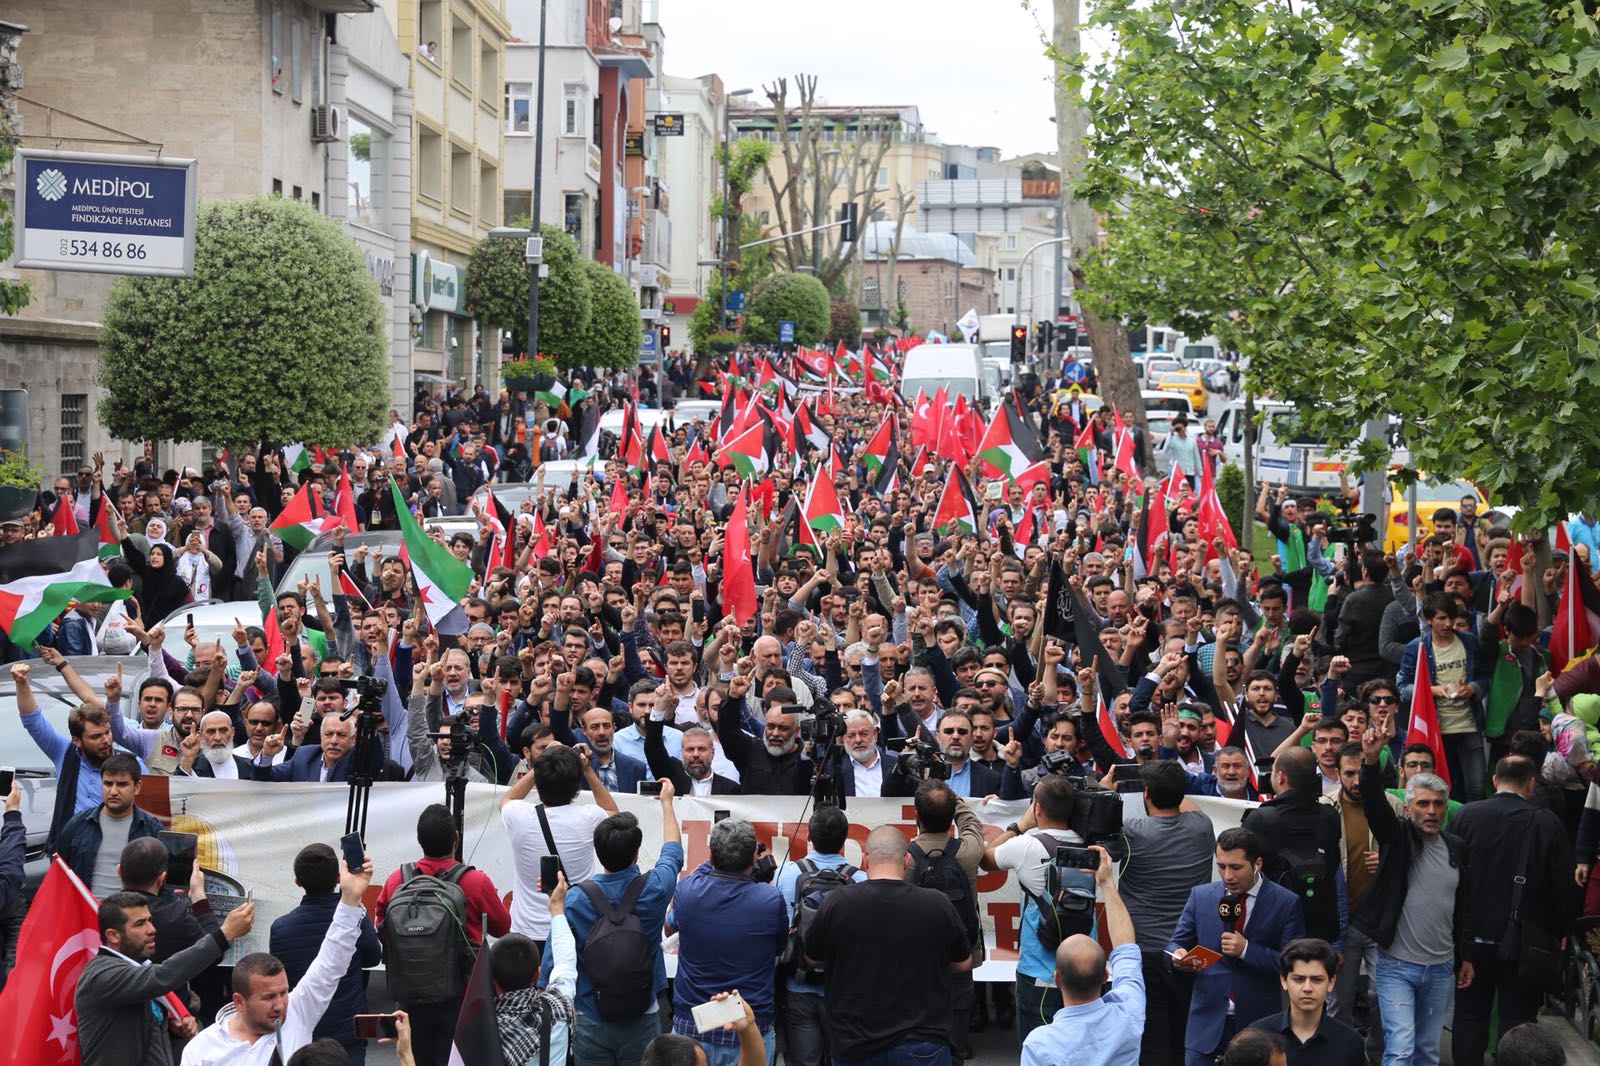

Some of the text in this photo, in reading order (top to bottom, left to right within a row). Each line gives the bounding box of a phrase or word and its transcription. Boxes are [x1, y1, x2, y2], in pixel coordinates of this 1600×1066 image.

[72, 177, 154, 198] MEDİPOL
[72, 205, 144, 215] MEDİPOL ÜNİVERSİTESİ
[72, 214, 172, 228] FINDIKZADE HASTANESİ
[70, 239, 98, 257] 534
[102, 241, 123, 258] 86
[126, 243, 147, 260] 86
